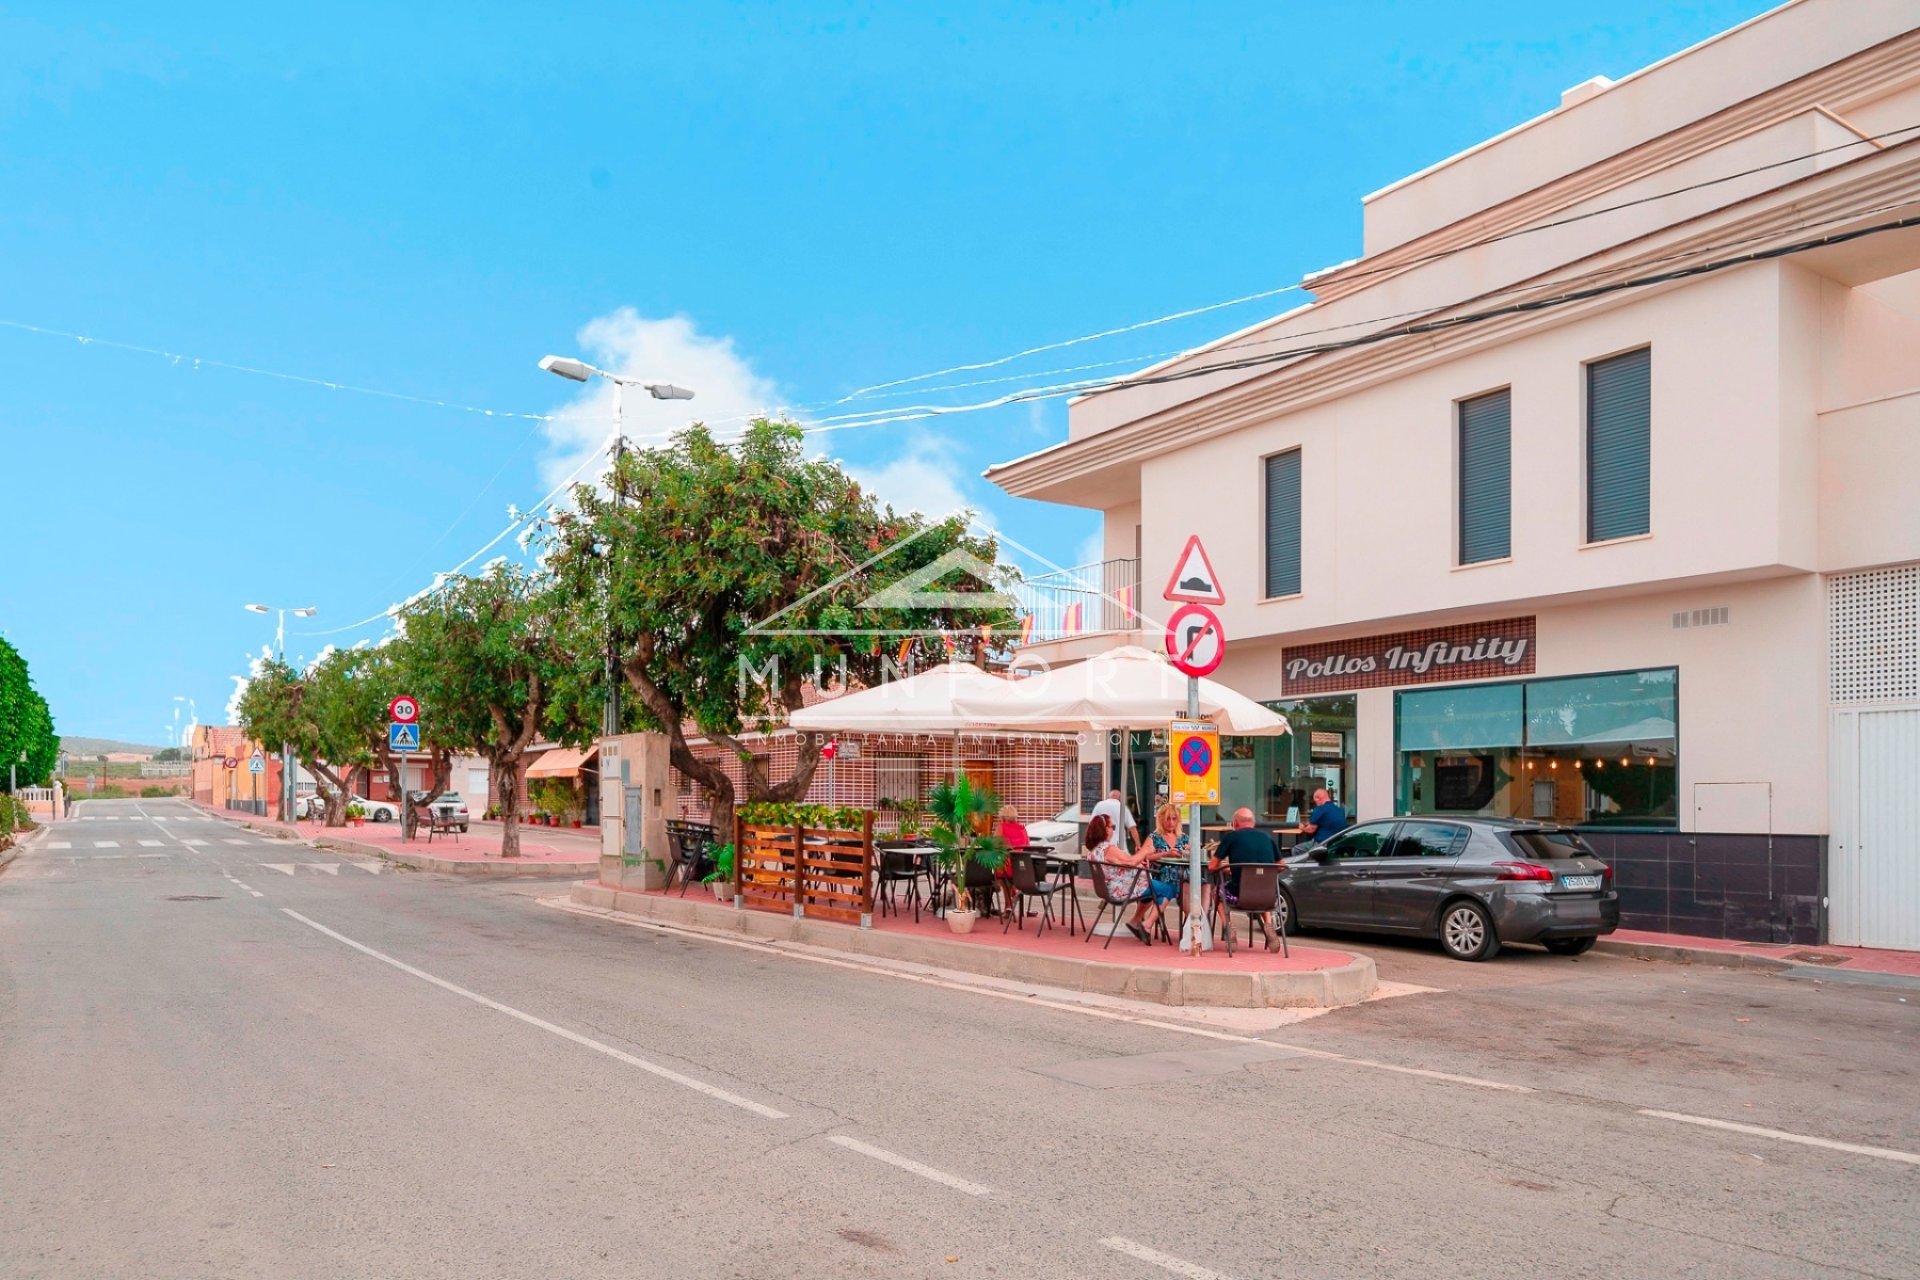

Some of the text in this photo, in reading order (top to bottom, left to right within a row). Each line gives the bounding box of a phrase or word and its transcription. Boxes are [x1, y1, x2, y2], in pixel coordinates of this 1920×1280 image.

[1286, 637, 1528, 680] Pollos Infinity
[397, 705, 413, 715] 30
